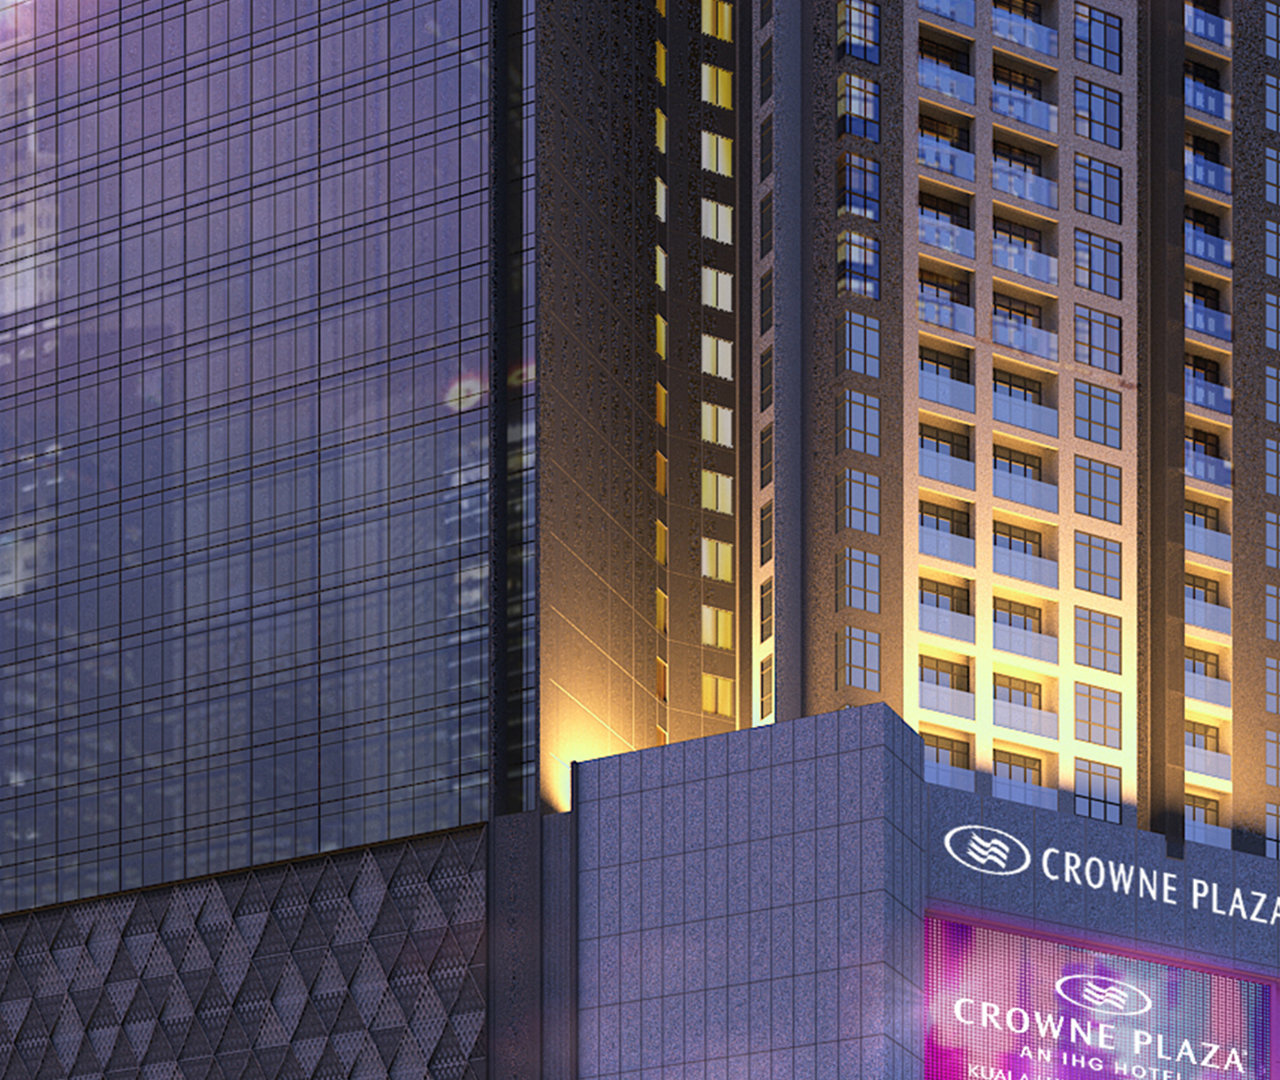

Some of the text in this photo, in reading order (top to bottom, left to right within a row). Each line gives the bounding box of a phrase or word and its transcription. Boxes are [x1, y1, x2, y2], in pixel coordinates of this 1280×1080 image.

[1042, 847, 1177, 905] CROWNE
[954, 998, 1246, 1074] CROWNE PLAZA
[1019, 1045, 1051, 1063] AN
[1061, 1053, 1104, 1072] IHG
